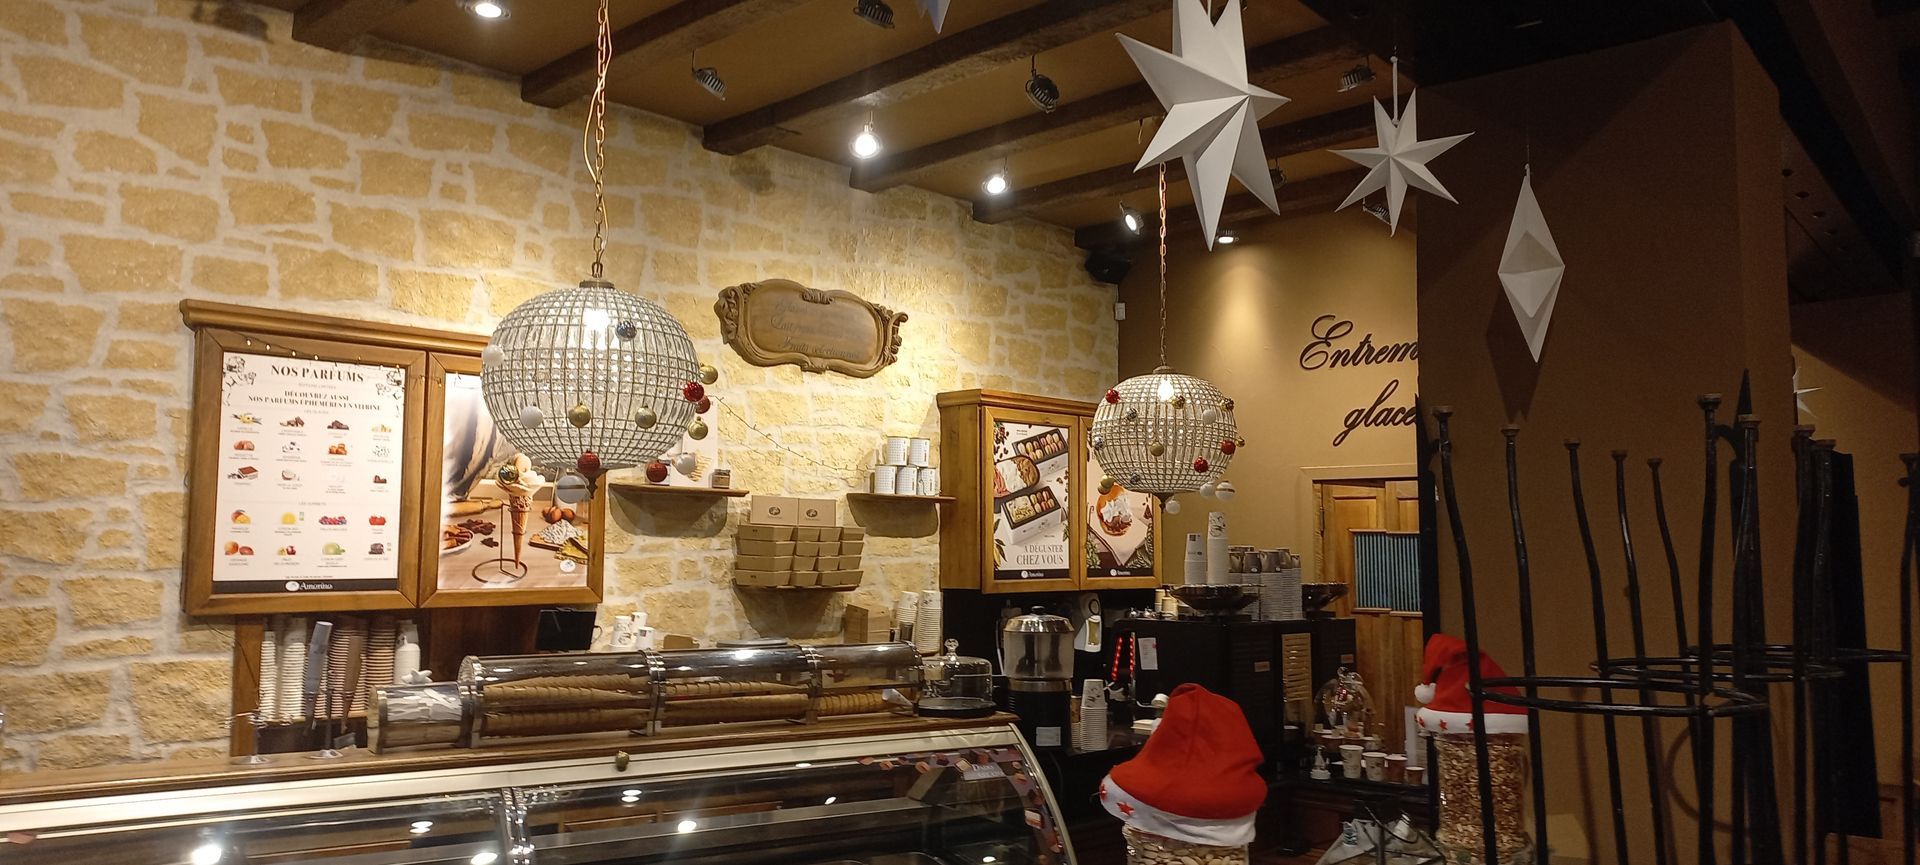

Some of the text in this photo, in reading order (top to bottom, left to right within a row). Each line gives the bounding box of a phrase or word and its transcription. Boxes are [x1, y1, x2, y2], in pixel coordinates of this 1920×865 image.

[271, 364, 364, 382] NOS PARFUMS
[264, 396, 299, 405] PARFUMS
[1016, 554, 1064, 565] CHEZ VOUS
[300, 581, 333, 590] Amorino
